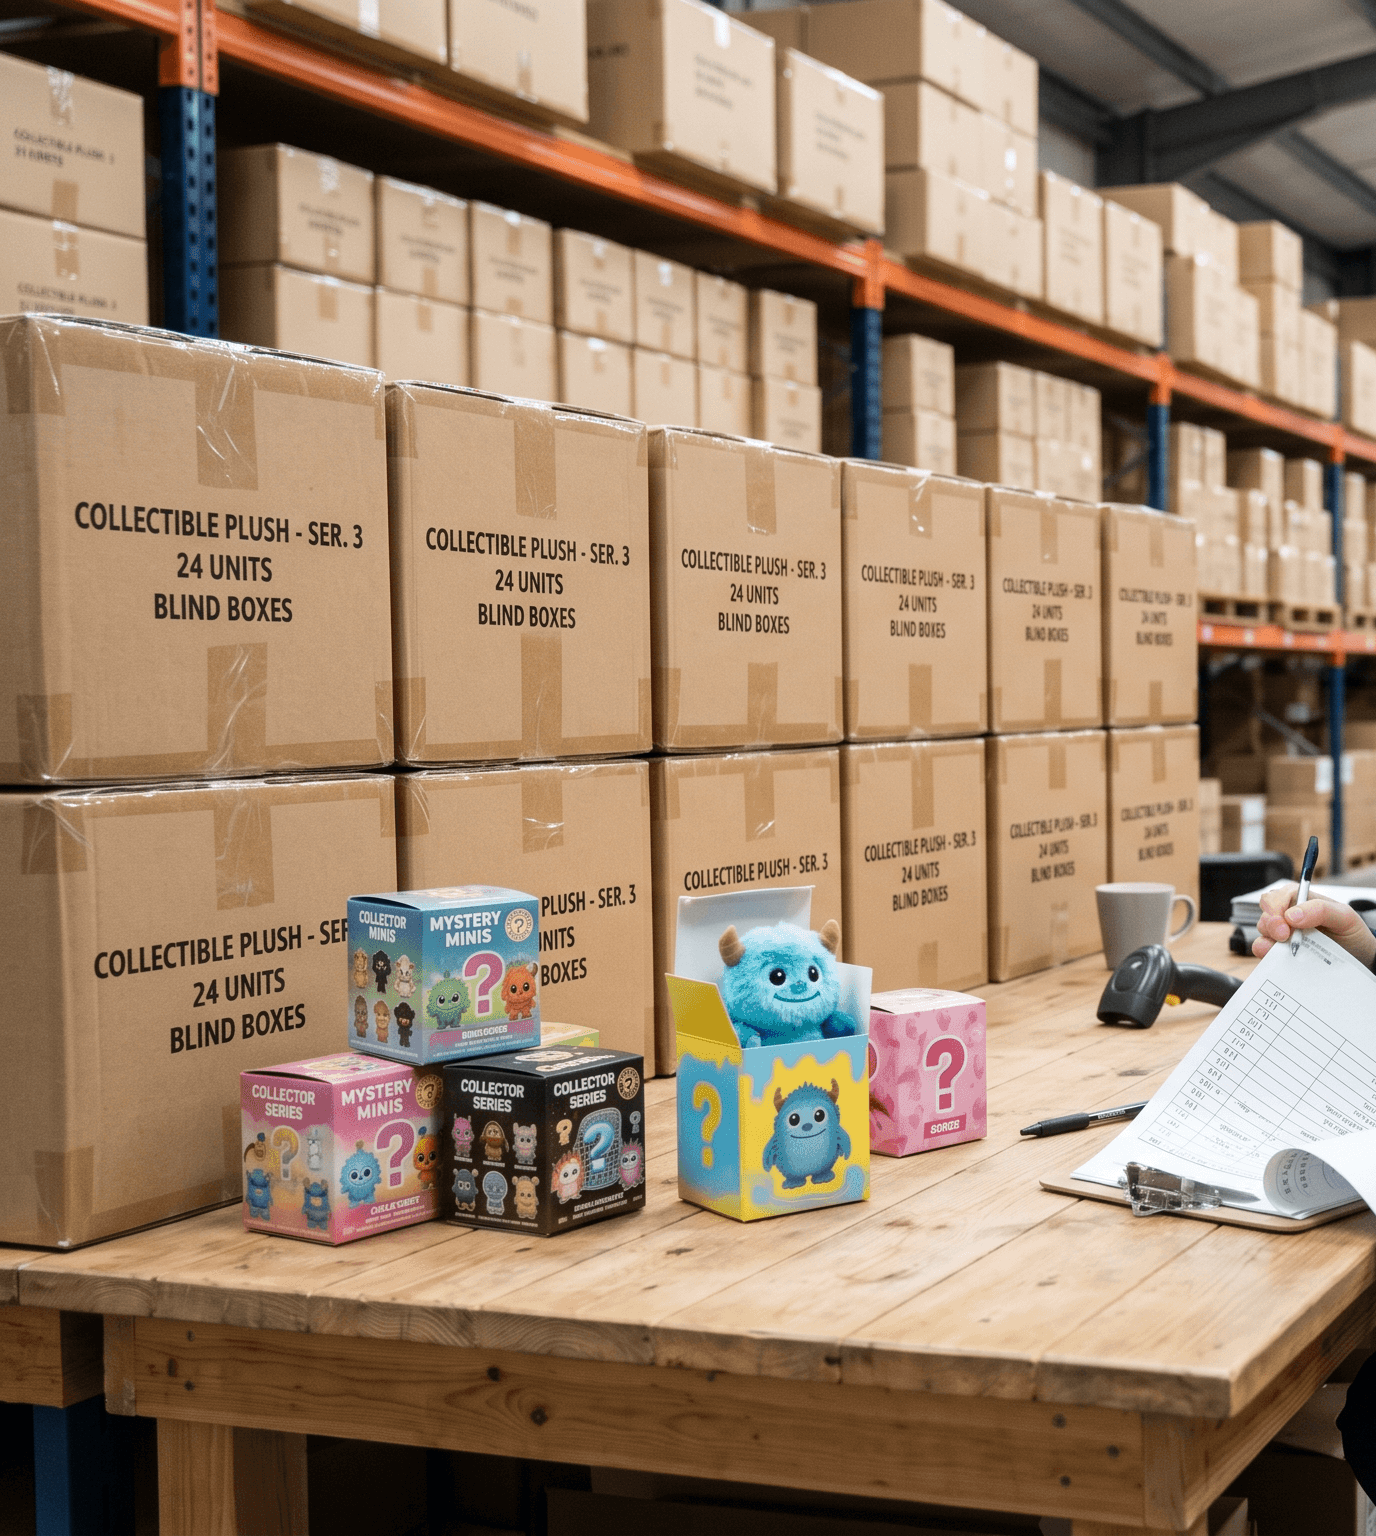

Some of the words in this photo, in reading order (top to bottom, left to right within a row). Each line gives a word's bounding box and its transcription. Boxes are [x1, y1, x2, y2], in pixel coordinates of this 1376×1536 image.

[75, 501, 219, 538] COLLECTIBLE
[225, 513, 289, 543] PLUSH
[308, 521, 348, 548] SER.
[353, 524, 363, 549] 3
[426, 527, 526, 557] COLLECTIBLE
[531, 537, 576, 561] PLUSH
[590, 542, 618, 565] SER.
[622, 545, 630, 566] 3
[177, 552, 203, 579] 24
[210, 554, 272, 582] UNITS
[682, 548, 752, 573] COLLECTIBLE
[755, 556, 787, 576] PLUSH
[797, 560, 818, 579] SER.
[821, 562, 826, 580] 3
[861, 564, 916, 586] COLLECTIBLE
[919, 569, 943, 587] PLUSH
[970, 574, 975, 590] 3
[495, 569, 514, 591] 24
[518, 570, 563, 595] UNITS
[730, 583, 743, 602] 24
[747, 584, 779, 605] UNITS
[154, 593, 220, 621] BLIND
[228, 596, 293, 622] BOXES
[478, 603, 524, 626] BLIND
[529, 605, 576, 628] BOXES
[899, 594, 909, 611] 24
[911, 595, 937, 613] UNITS
[718, 612, 752, 632] BLIND
[756, 614, 790, 634] BOXES
[890, 619, 916, 637] BLIND
[919, 621, 946, 638] BOXES
[864, 838, 918, 862] COLLECTIBLE
[921, 834, 946, 854] PLUSH
[684, 863, 755, 891] COLLECTIBLE
[758, 858, 790, 880] PLUSH
[799, 854, 820, 874] SER.
[822, 853, 828, 870] 3
[902, 866, 912, 884] 24
[914, 861, 940, 881] UNITS
[542, 890, 586, 917] PLUSH
[598, 886, 626, 909] SER.
[629, 884, 636, 904] 3
[893, 890, 919, 912] BLIND
[921, 885, 948, 906] BOXES
[359, 910, 407, 929] COLLECTOR
[430, 911, 501, 932] MYSTERY
[368, 926, 396, 943] MINIS
[445, 928, 492, 948] MINIS
[94, 934, 234, 979] COLLECTIBLE
[240, 924, 302, 957] PLUSH
[462, 950, 505, 1017] ?
[541, 957, 587, 987] BOXES
[193, 979, 219, 1008] 24
[225, 967, 285, 1001] UNITS
[170, 1017, 235, 1054] BLIND
[242, 1003, 306, 1040] BOXES
[553, 1072, 616, 1097] COLLECTOR
[923, 1034, 967, 1113] ?
[252, 1084, 316, 1105] COLLECTOR
[341, 1078, 413, 1106] MYSTERY
[460, 1079, 525, 1098] COLLECTOR
[569, 1089, 607, 1109] SERIES
[265, 1103, 303, 1120] SERIES
[357, 1098, 403, 1121] MINIS
[473, 1096, 512, 1113] SERIES
[693, 1081, 722, 1168] ?
[374, 1118, 417, 1190] ?
